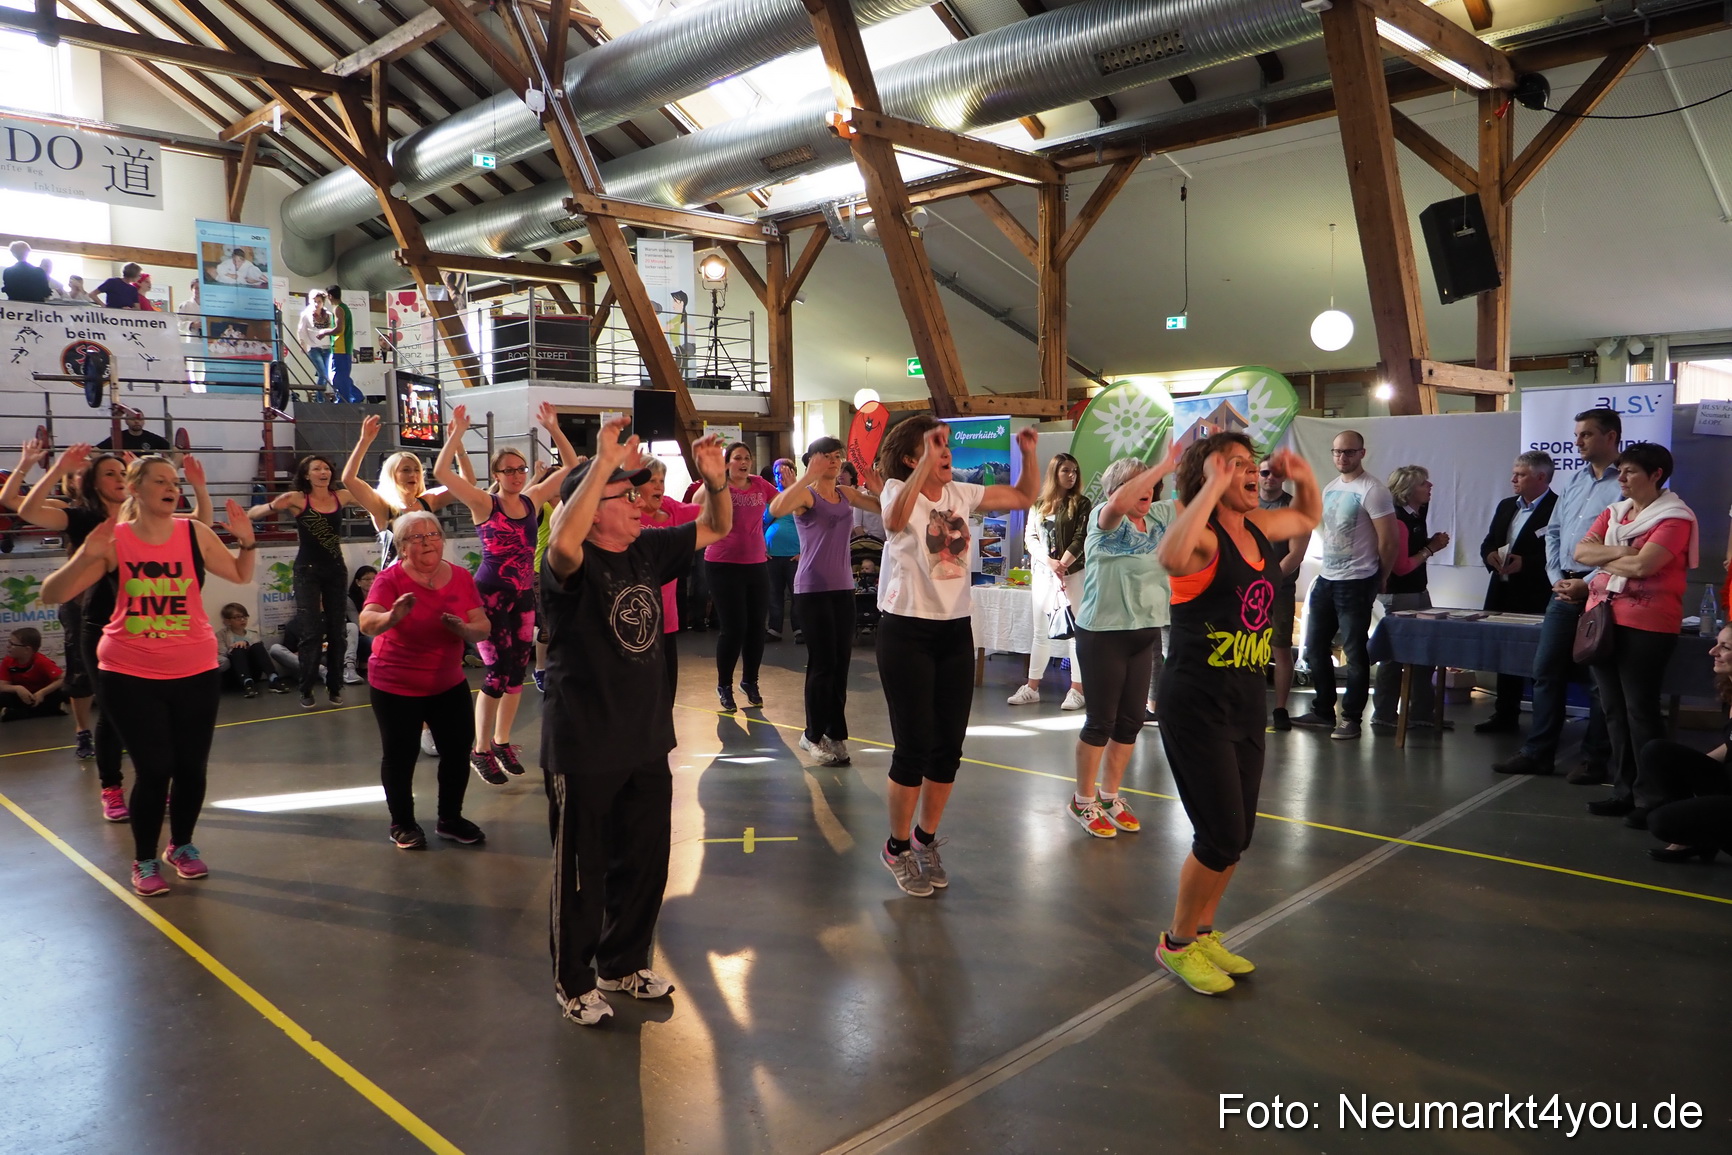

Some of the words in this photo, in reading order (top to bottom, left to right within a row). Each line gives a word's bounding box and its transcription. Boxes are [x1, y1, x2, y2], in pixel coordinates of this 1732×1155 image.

[3, 126, 83, 170] DO
[102, 145, 156, 197] 道
[34, 181, 85, 196] Inklusion
[70, 312, 167, 329] willkommen
[66, 327, 106, 341] beim
[508, 351, 531, 361] BOD
[537, 351, 568, 360] STREET
[1700, 411, 1731, 419] Neumarkt
[955, 430, 997, 444] Olpererhütte
[125, 561, 183, 578] YOU
[125, 578, 194, 597] ONLY
[126, 596, 187, 616] LIVE
[0, 609, 59, 623] EUMAR
[125, 615, 191, 634] ONCE
